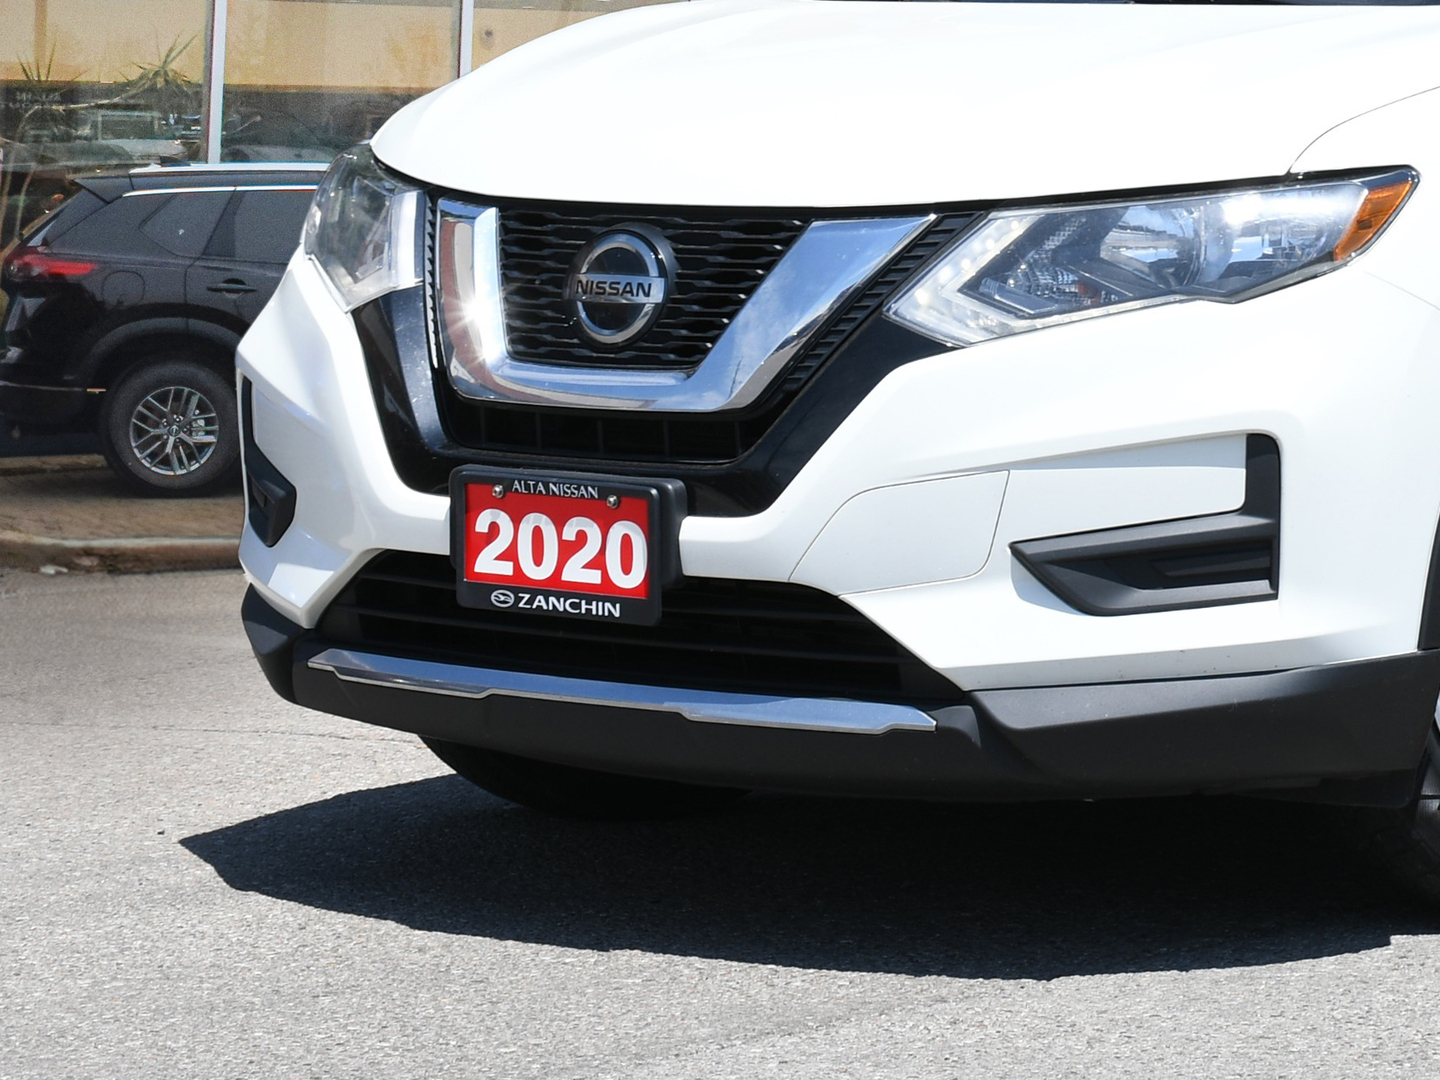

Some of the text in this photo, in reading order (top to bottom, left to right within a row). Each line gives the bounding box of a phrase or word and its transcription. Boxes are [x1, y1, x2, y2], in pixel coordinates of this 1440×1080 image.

[575, 279, 652, 298] NISSAN
[511, 479, 599, 499] ALTA NISSAN
[473, 508, 649, 590] 2020
[517, 593, 621, 618] ZANCHIN
